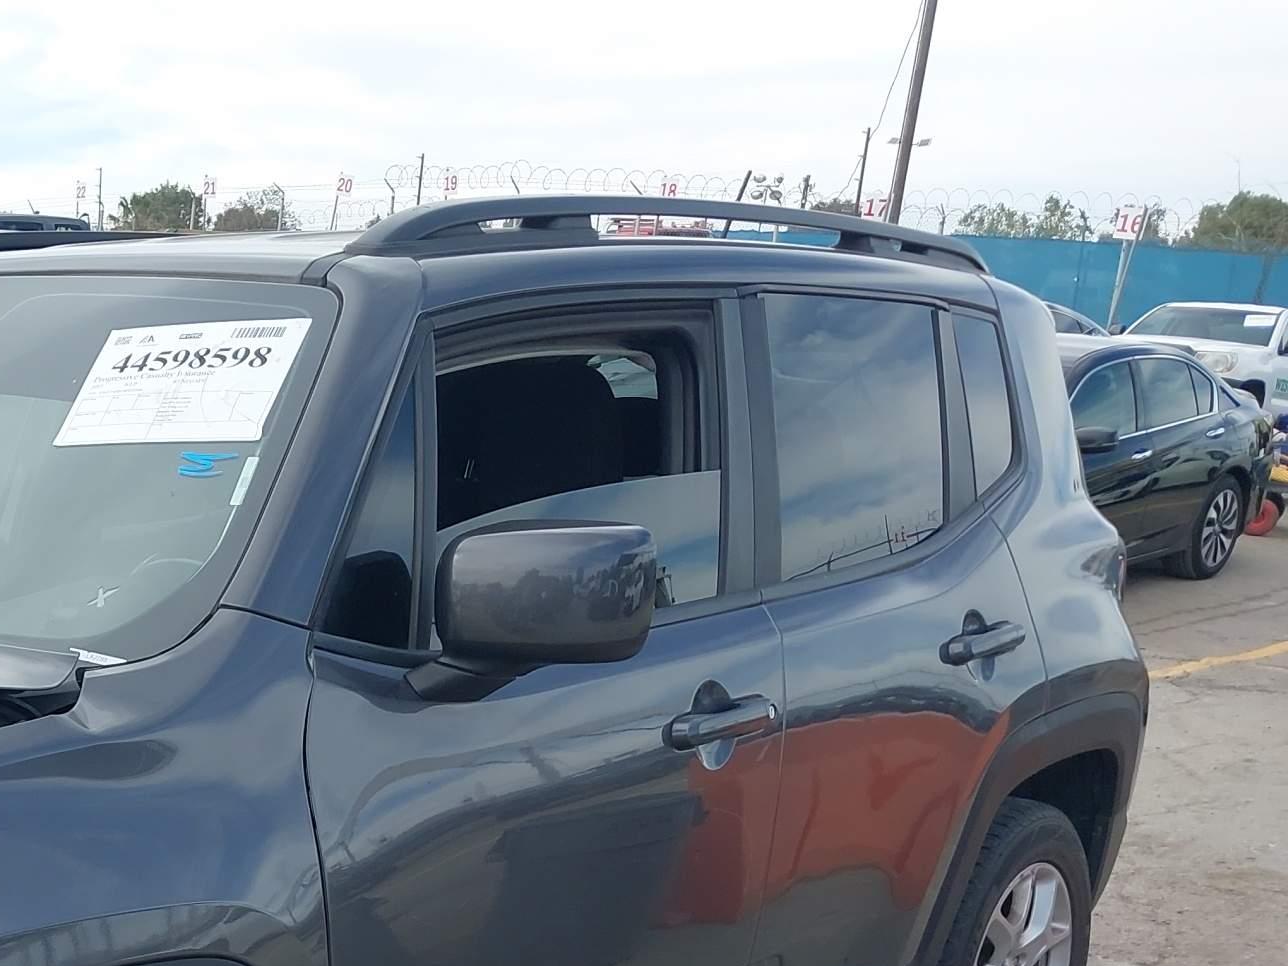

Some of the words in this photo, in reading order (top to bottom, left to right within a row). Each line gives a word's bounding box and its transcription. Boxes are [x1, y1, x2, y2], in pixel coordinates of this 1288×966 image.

[203, 181, 216, 195] 21
[337, 177, 353, 193] 20
[444, 175, 457, 191] 19
[863, 198, 888, 217] 17
[1116, 213, 1142, 233] 16
[111, 346, 272, 374] 44598598
